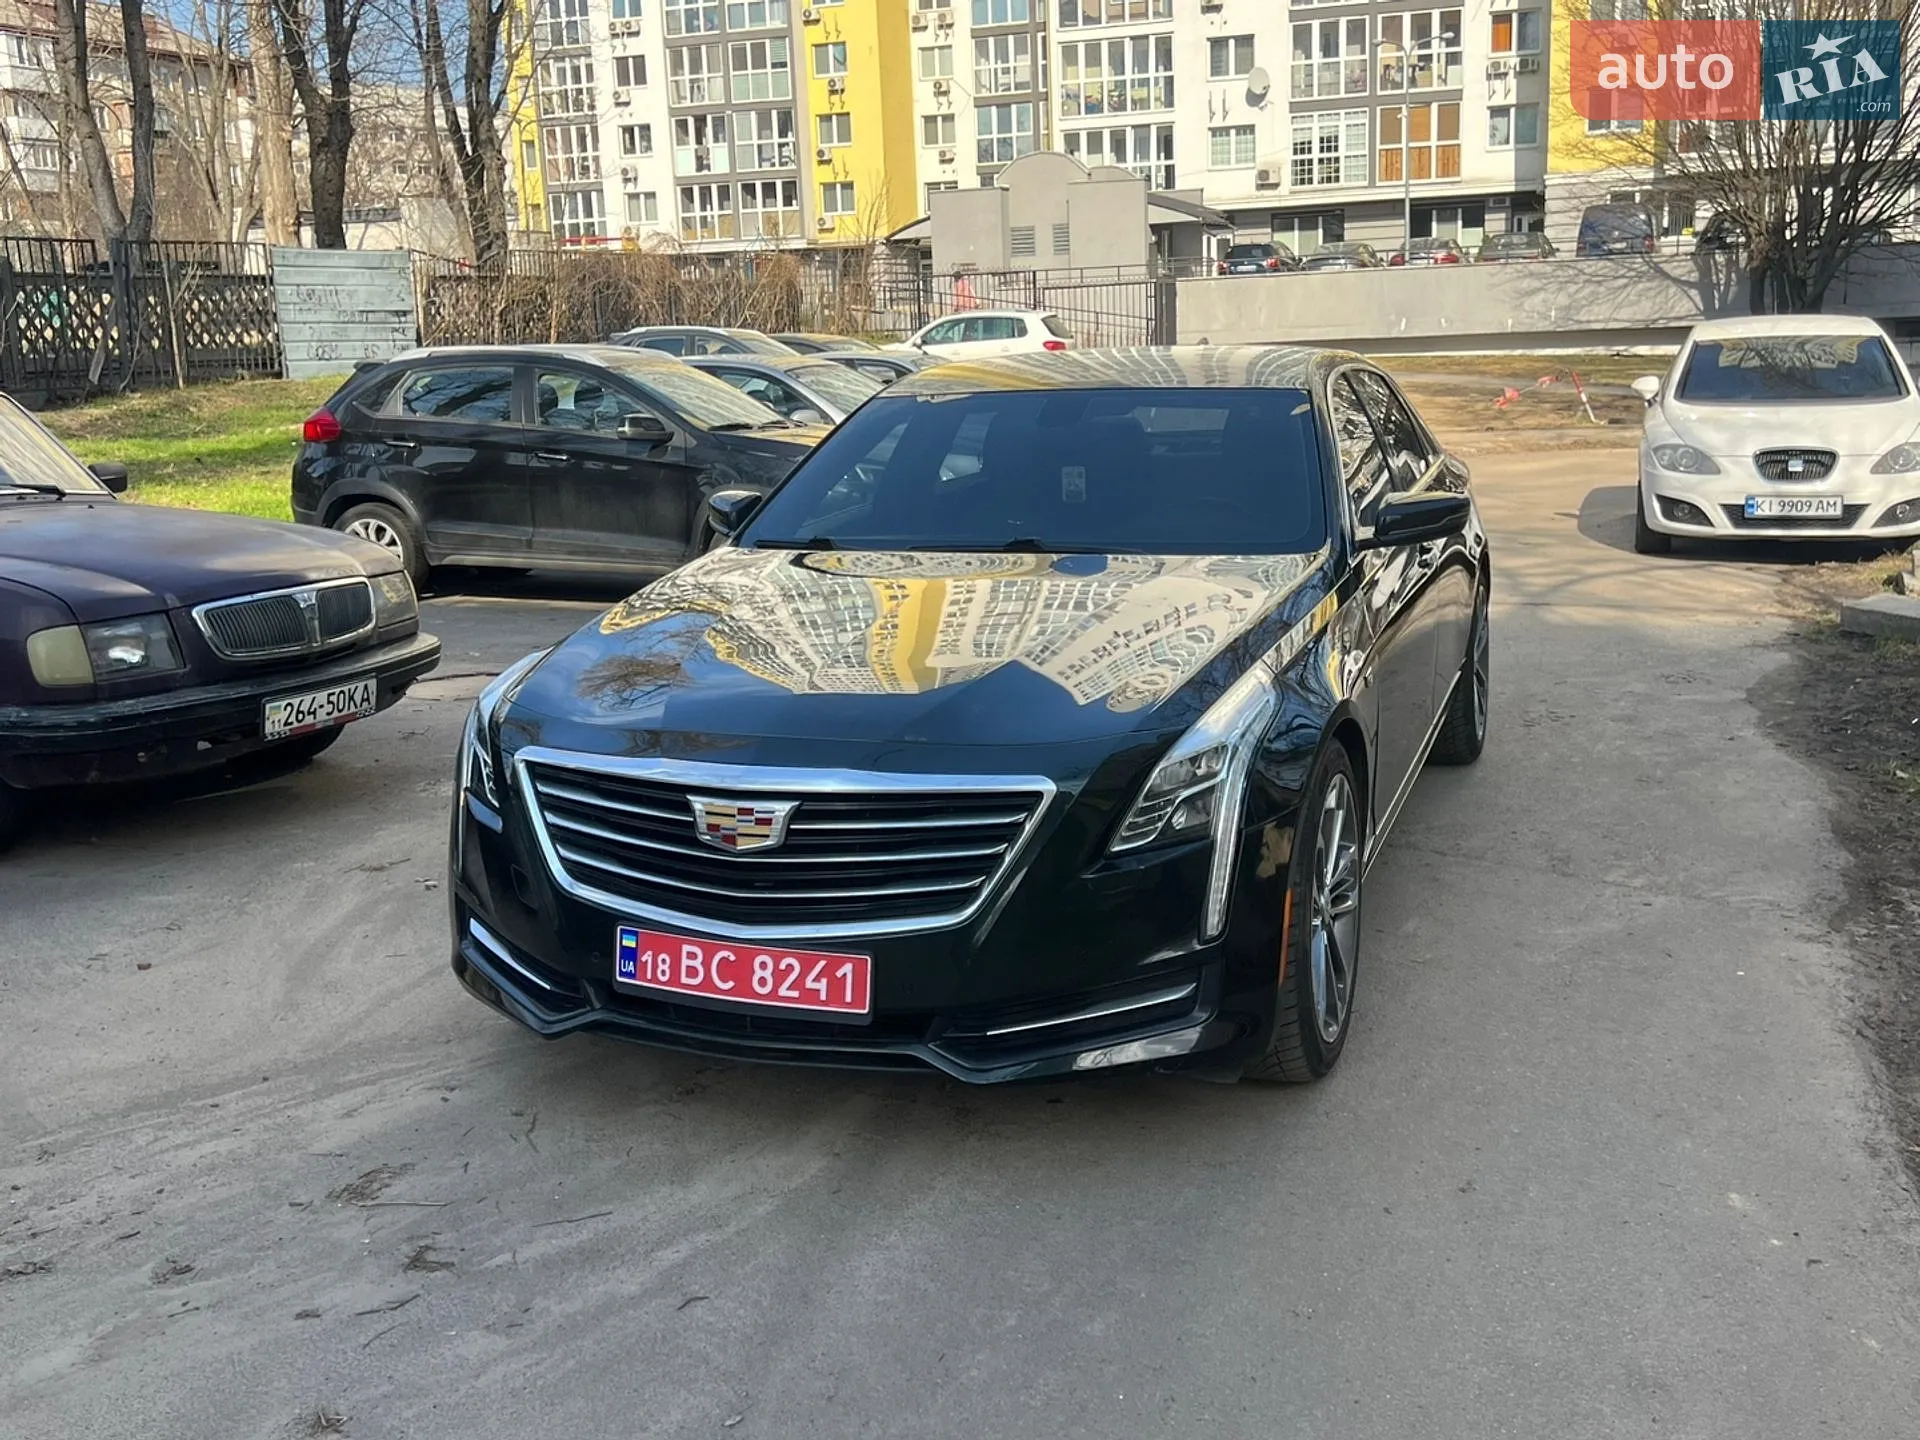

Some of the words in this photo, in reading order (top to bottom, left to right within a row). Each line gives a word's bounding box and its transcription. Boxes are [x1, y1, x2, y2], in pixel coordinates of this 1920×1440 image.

[1778, 500, 1812, 513] 9909
[1815, 500, 1837, 513] AM
[283, 683, 371, 728] 264-50KA
[620, 959, 635, 974] UA
[640, 950, 671, 983] 18
[680, 944, 737, 991] BC
[751, 954, 854, 1004] 8241
